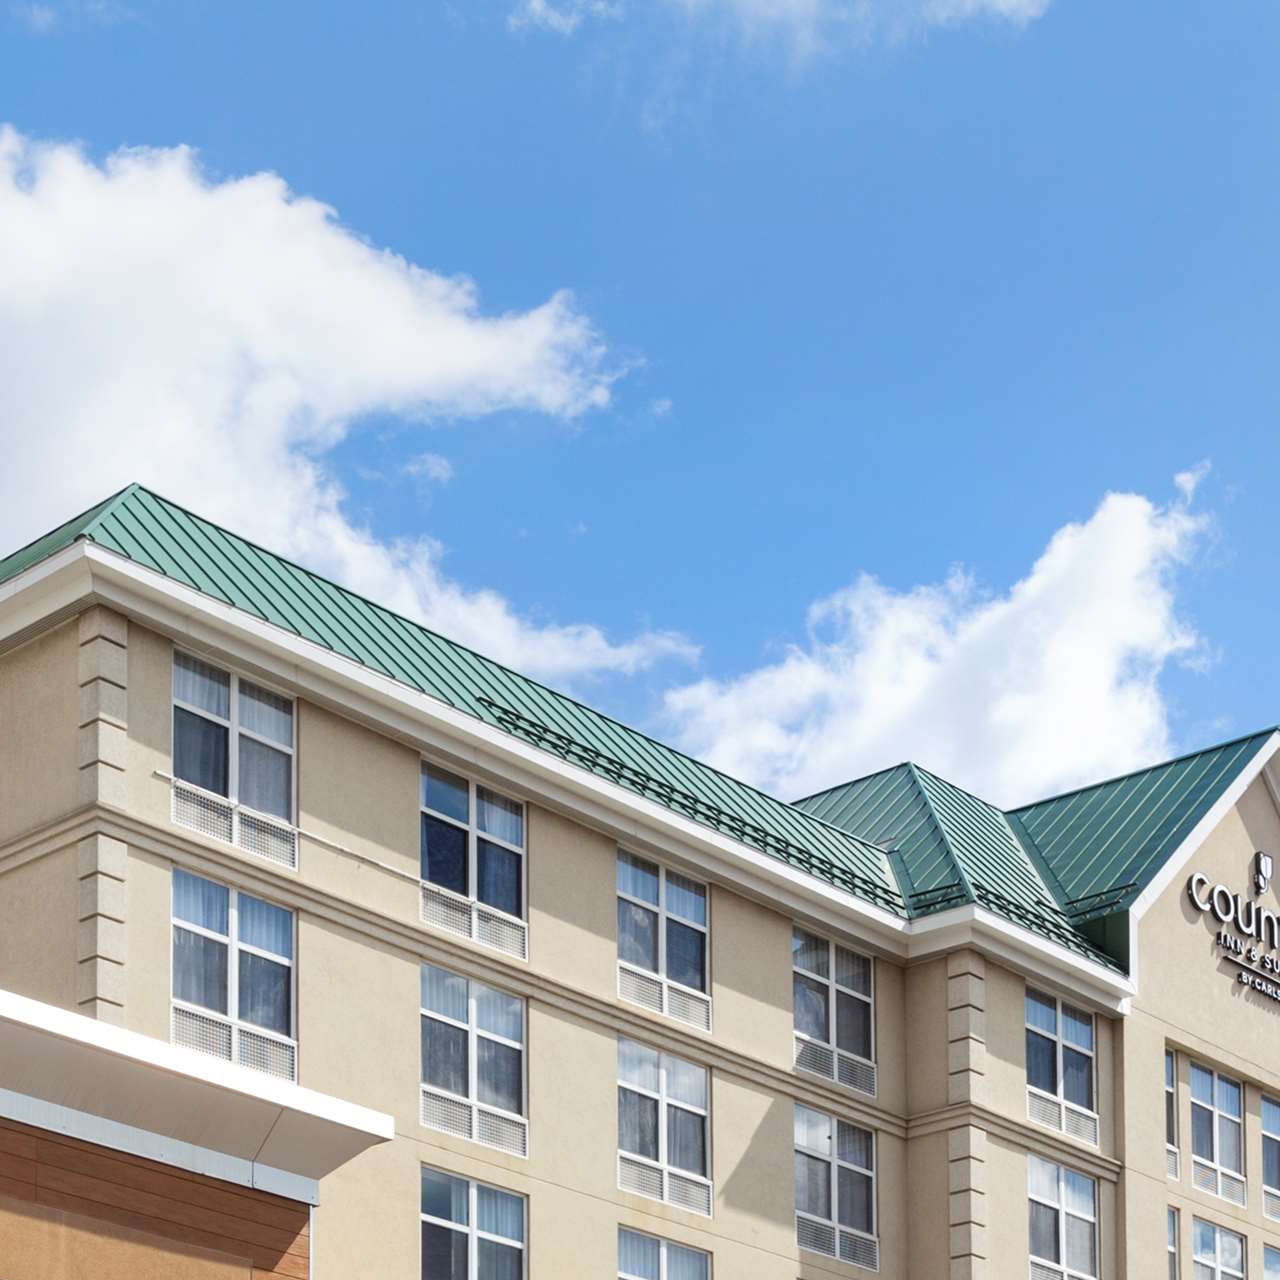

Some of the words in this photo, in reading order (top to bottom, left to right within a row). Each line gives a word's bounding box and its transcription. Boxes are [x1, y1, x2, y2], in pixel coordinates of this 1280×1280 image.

[1218, 932, 1245, 955] INN
[1248, 946, 1258, 962] &
[1239, 971, 1254, 987] BY
